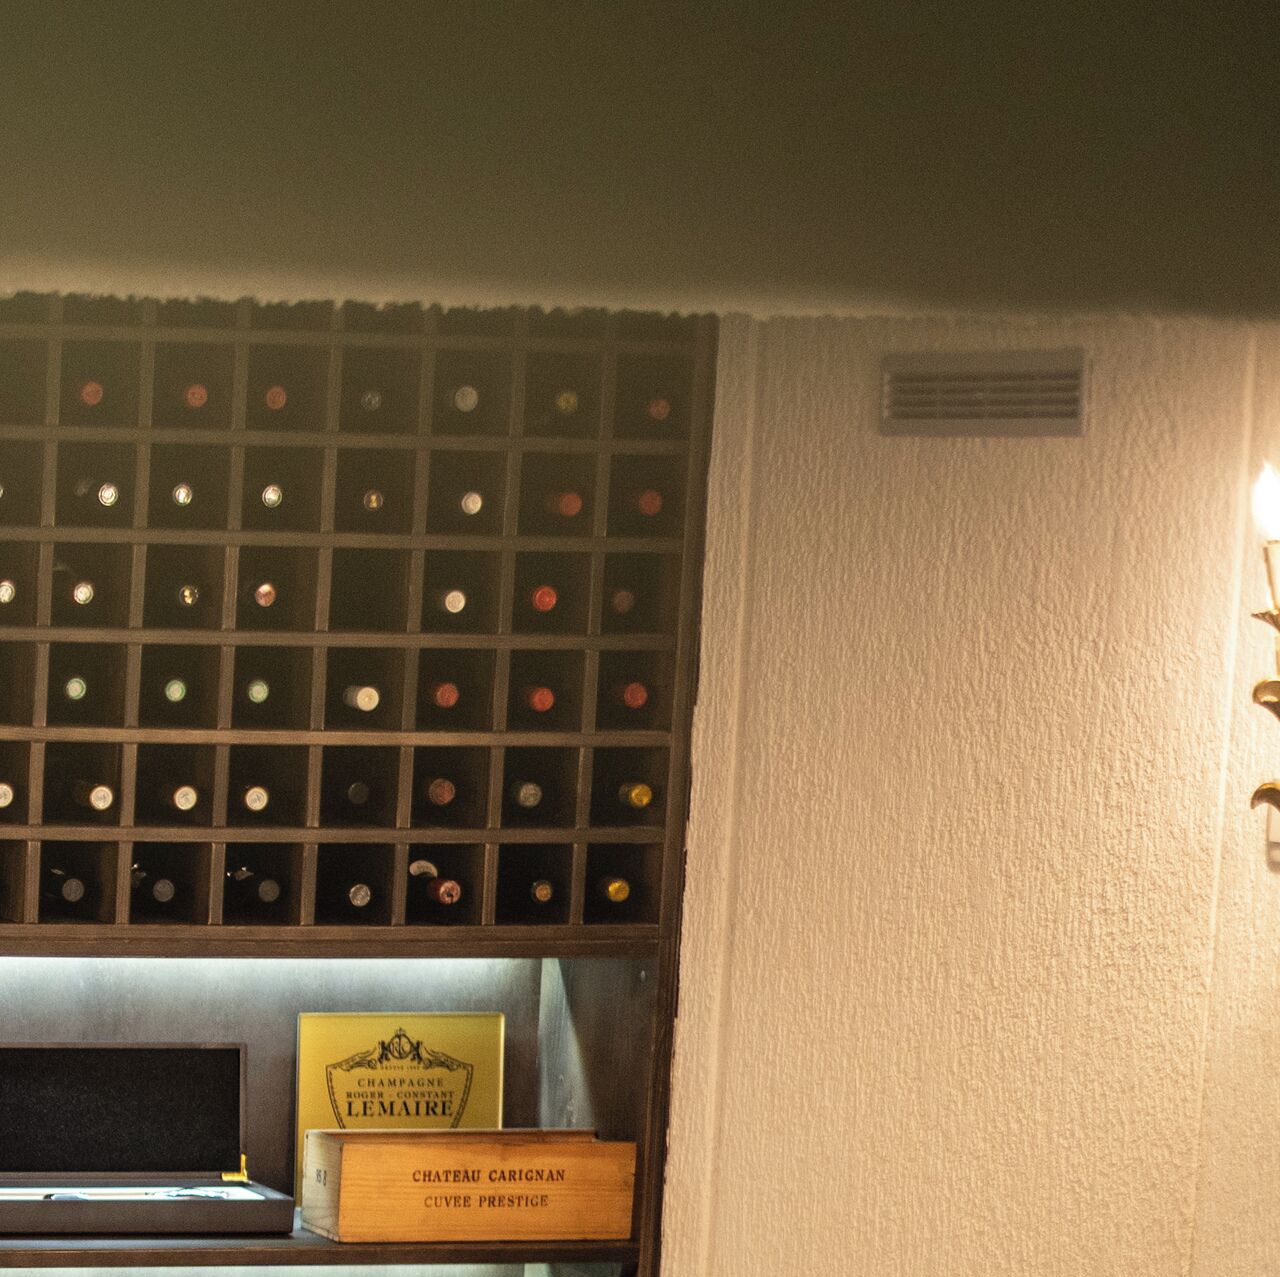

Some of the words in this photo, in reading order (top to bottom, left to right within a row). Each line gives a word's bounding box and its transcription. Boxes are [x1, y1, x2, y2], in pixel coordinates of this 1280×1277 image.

[358, 1077, 444, 1088] CHAMPAGNE
[346, 1091, 384, 1099] ROGER
[397, 1090, 455, 1099] CONSTANT
[346, 1101, 454, 1117] LEMAIRE
[413, 1169, 481, 1183] CHATEAU
[489, 1169, 566, 1182] CARIGNAN
[479, 1194, 549, 1207] PRESTIGE
